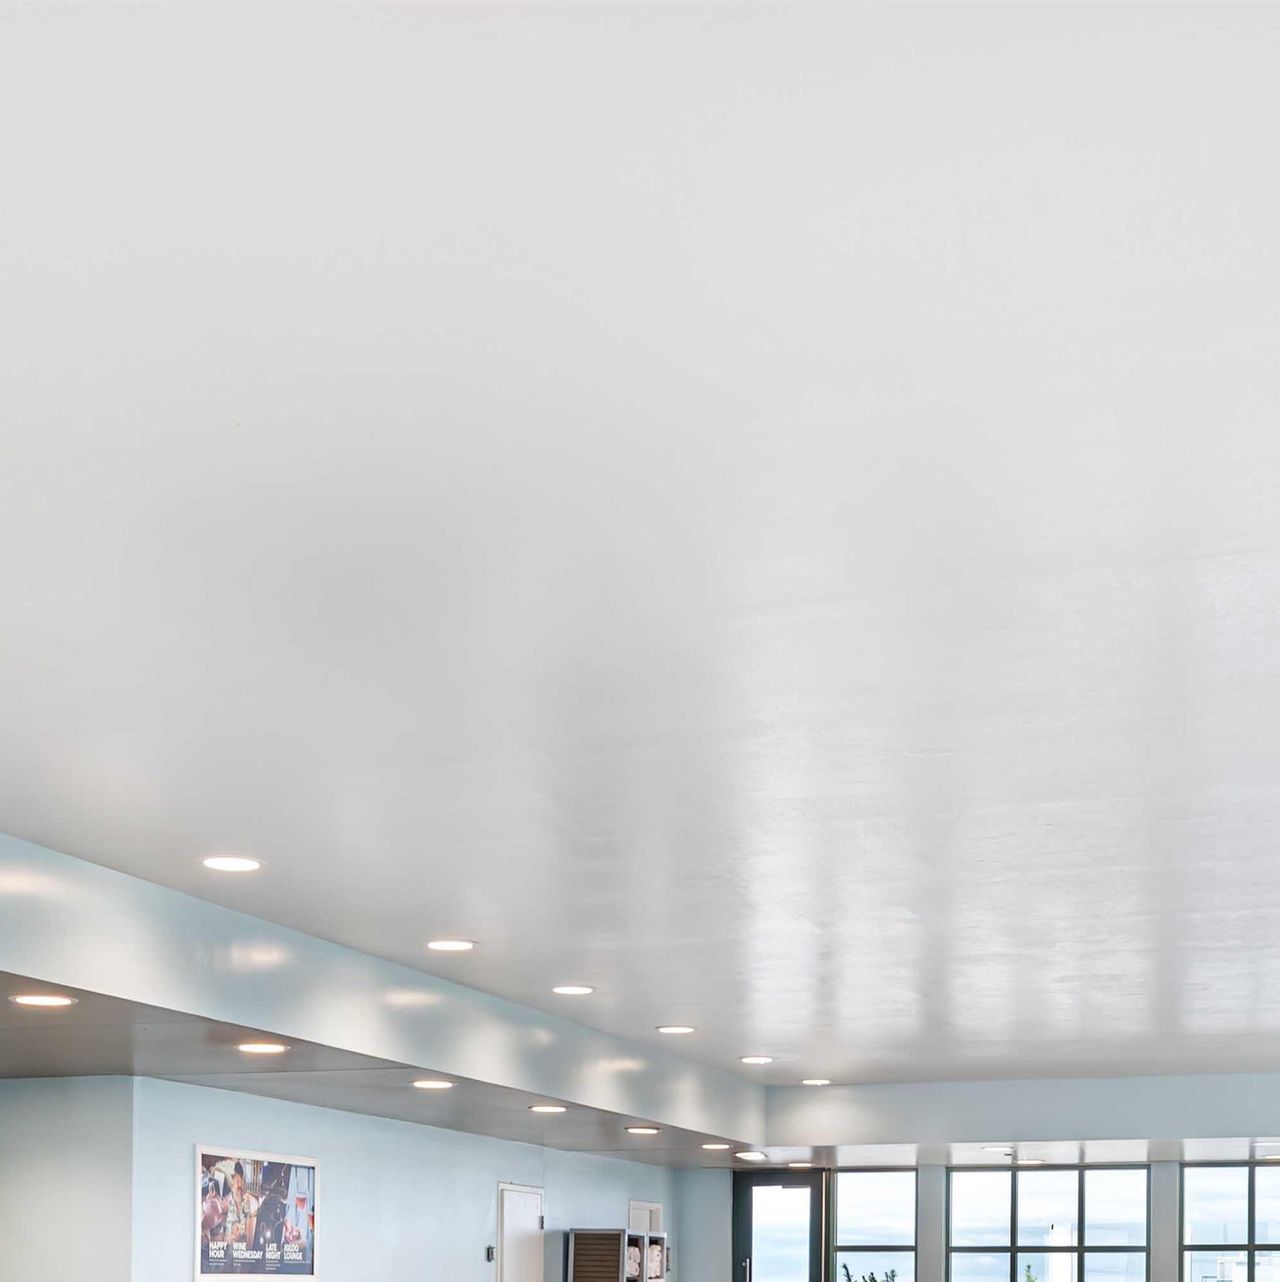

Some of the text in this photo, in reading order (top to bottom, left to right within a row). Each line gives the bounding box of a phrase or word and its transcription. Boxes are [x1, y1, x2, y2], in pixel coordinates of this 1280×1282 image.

[209, 1241, 227, 1250] HAPPY
[233, 1242, 246, 1250] WINE
[265, 1243, 277, 1251] LATE
[209, 1250, 225, 1258] HOUR
[233, 1250, 263, 1259] WEDNESDAY
[265, 1251, 281, 1259] NIGHT
[283, 1252, 303, 1260] LOUNGE
